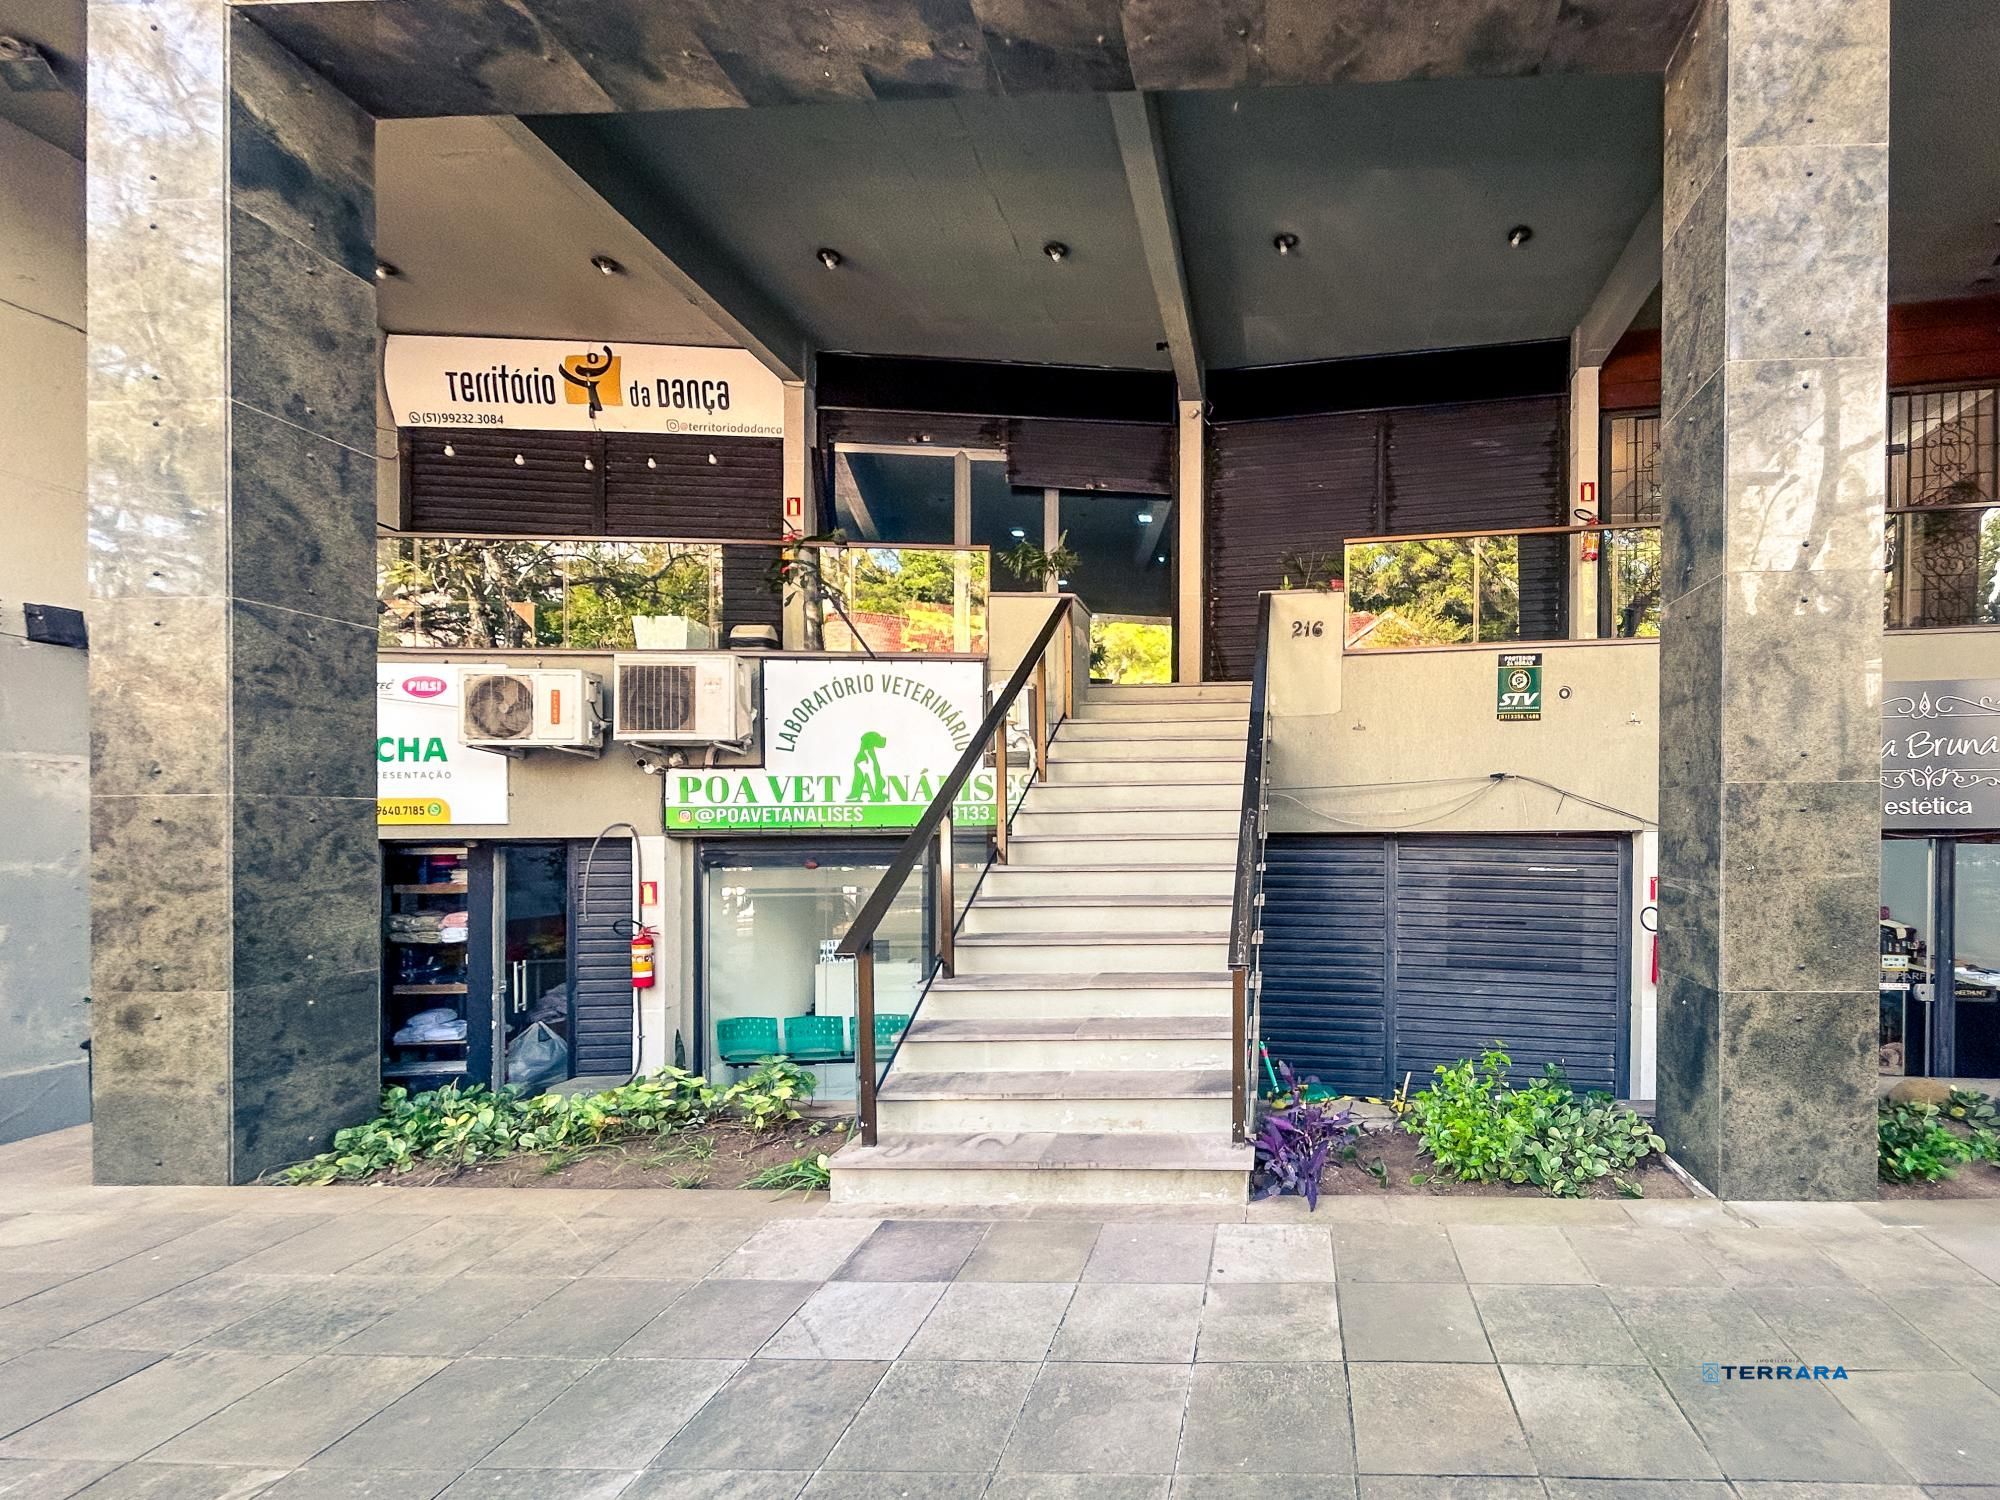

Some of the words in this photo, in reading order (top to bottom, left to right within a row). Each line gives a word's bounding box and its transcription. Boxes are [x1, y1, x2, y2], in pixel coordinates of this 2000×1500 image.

[445, 364, 555, 405] Território
[630, 380, 651, 408] da
[656, 378, 730, 415] Dança
[1291, 620, 1324, 639] 216
[1498, 692, 1540, 707] STV
[775, 673, 874, 752] LABORATÓRIO
[376, 736, 448, 762] CHA
[1905, 730, 2000, 760] Bruna
[377, 769, 452, 780] ESENTAÇÃO
[677, 775, 758, 804] POA
[765, 775, 841, 803] VET
[695, 807, 864, 824] @POAVETANALISES
[1884, 797, 1973, 815] estética
